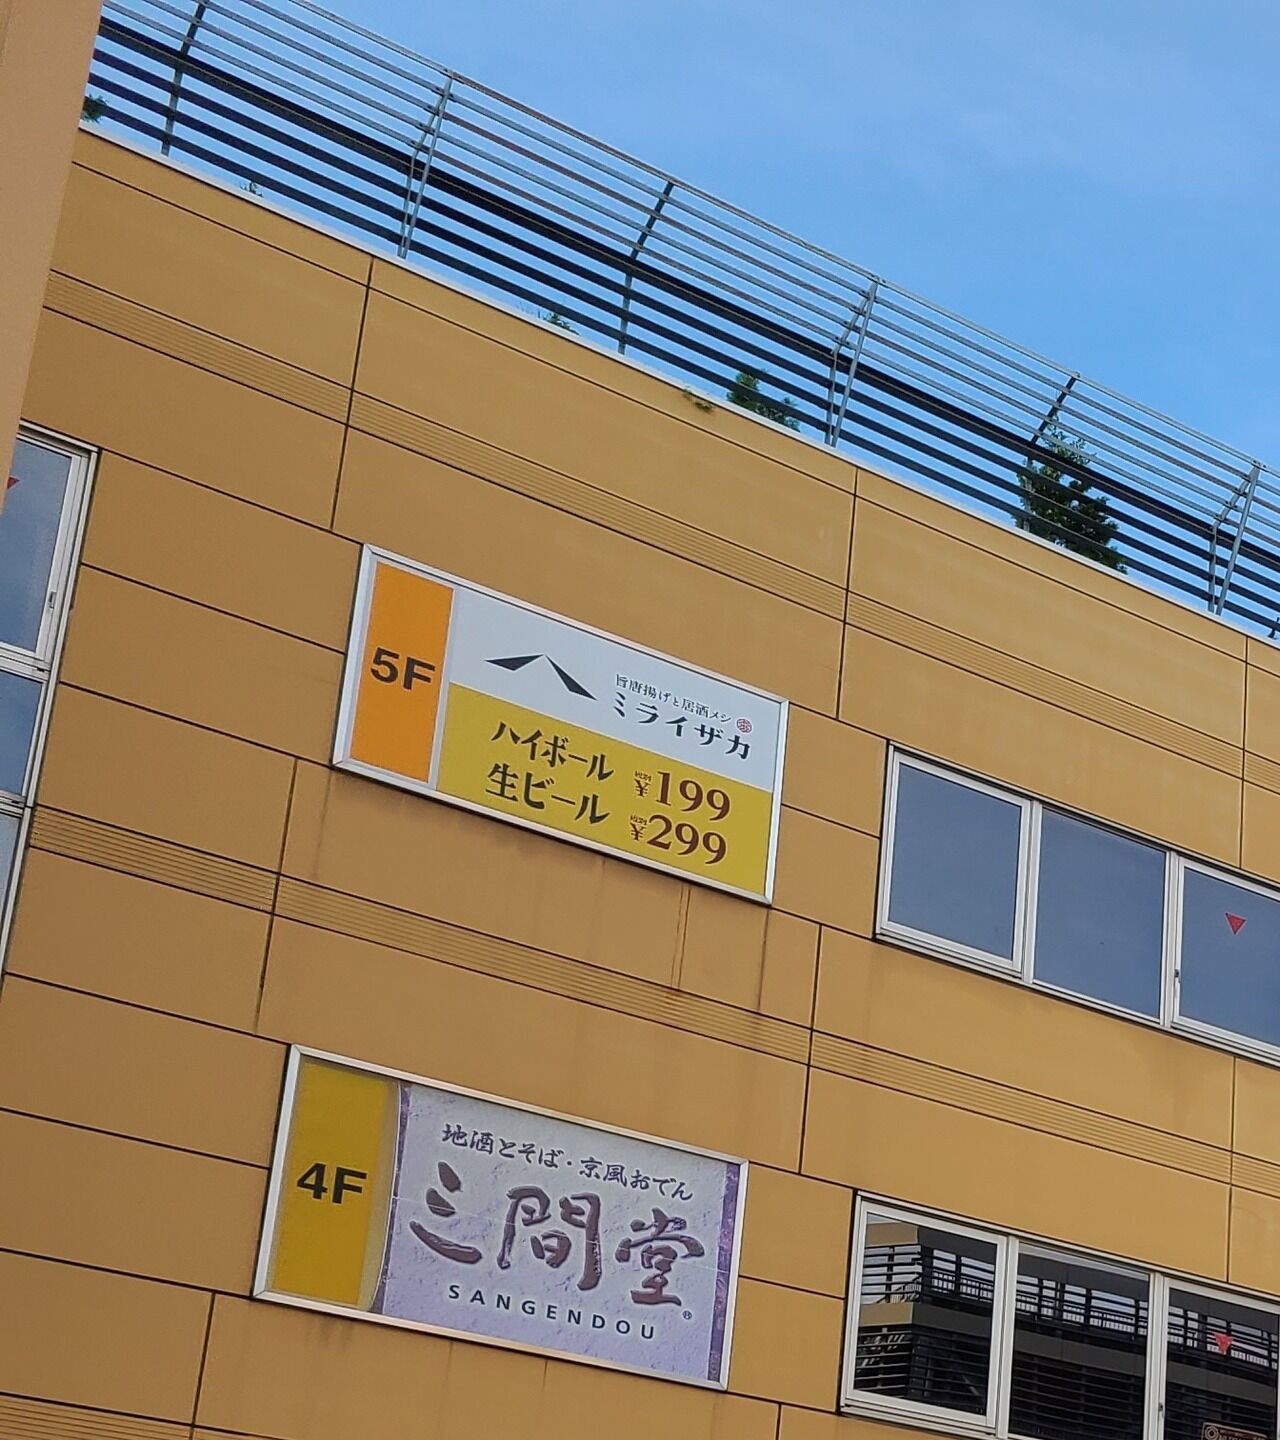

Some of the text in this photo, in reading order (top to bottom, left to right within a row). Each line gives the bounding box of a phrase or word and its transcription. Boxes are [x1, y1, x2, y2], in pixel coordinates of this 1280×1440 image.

[370, 646, 436, 691] 5F
[491, 719, 614, 783] ハイボール
[613, 691, 751, 760] ミライザカ
[485, 762, 611, 825] 生ビール
[296, 1162, 368, 1205] 4F
[449, 1283, 656, 1341] SANGENDOU
